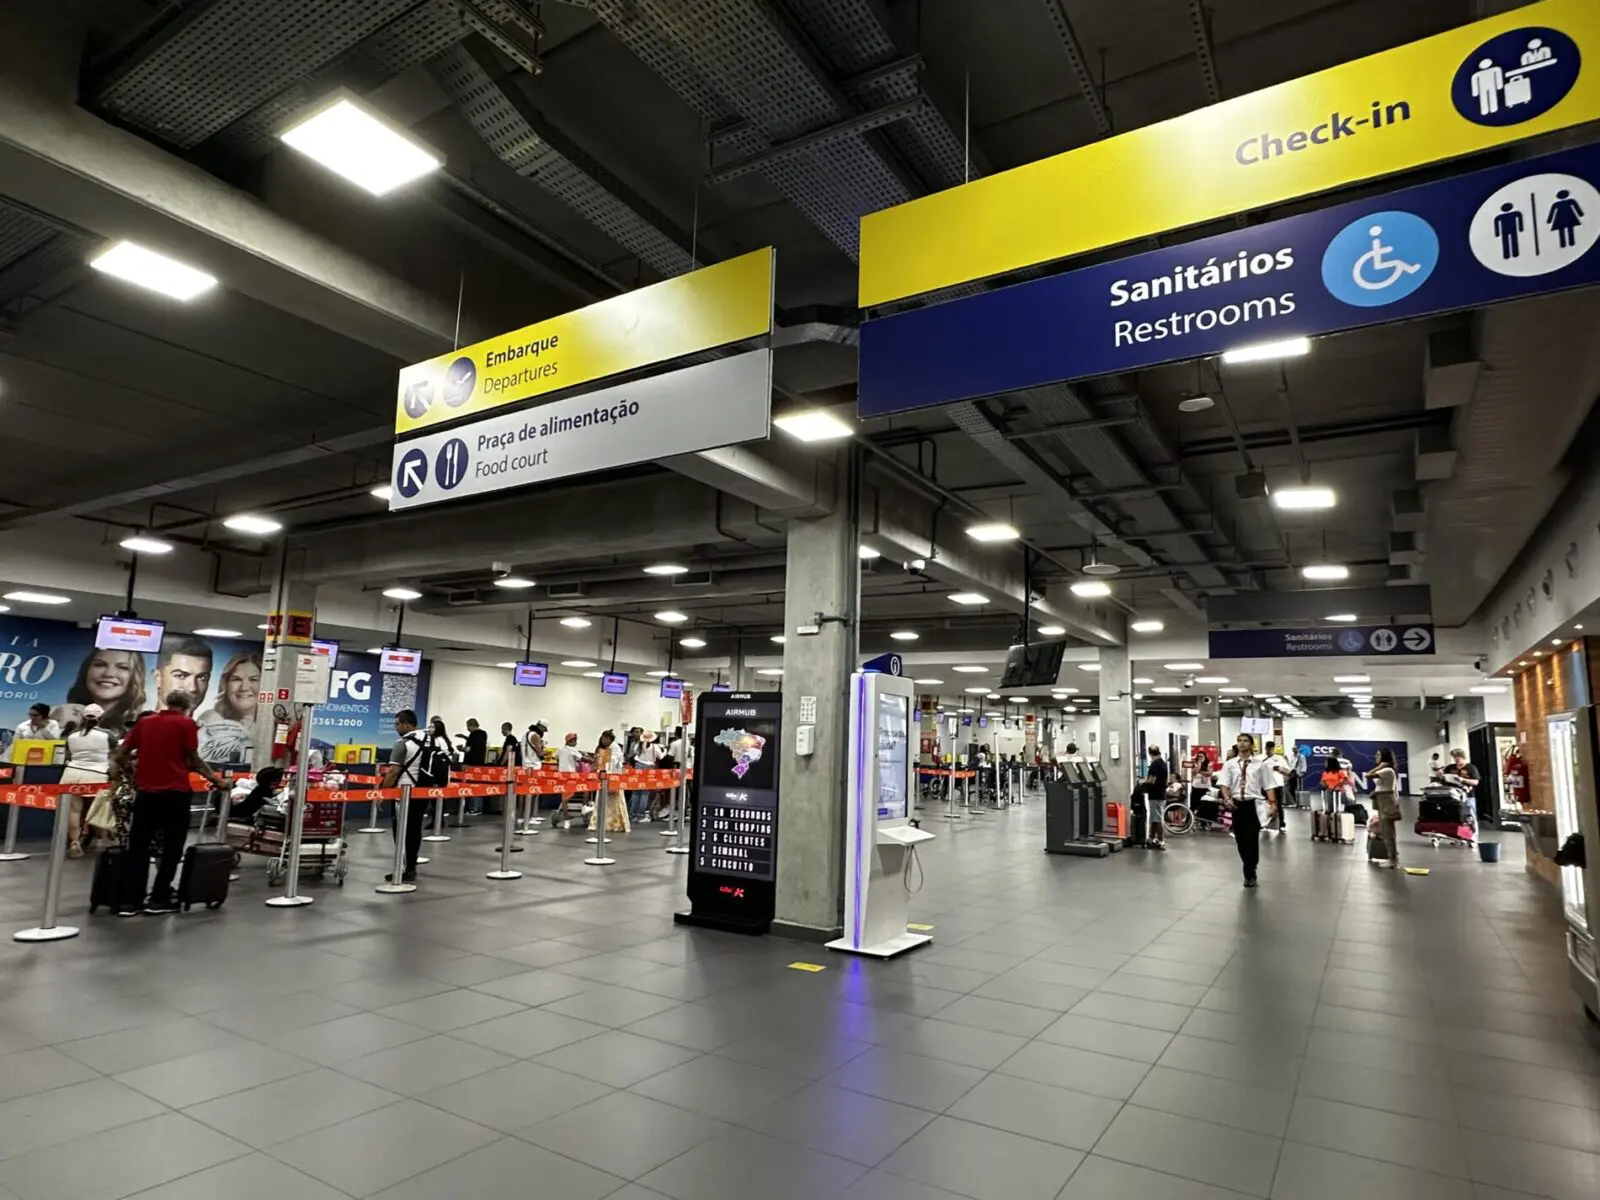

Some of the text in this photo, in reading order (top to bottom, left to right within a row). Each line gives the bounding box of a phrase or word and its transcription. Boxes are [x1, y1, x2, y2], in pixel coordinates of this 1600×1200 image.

[1236, 100, 1410, 165] Check-in
[1110, 247, 1294, 306] Sanitários
[1114, 292, 1296, 347] Restrooms
[486, 335, 559, 368] Embarque
[484, 361, 558, 394] Departures
[477, 399, 640, 452] Praça de alimentação
[475, 448, 549, 478] Food court
[1284, 632, 1333, 641] Sanitários
[1286, 642, 1333, 651] Restrooms
[330, 670, 371, 700] FG
[329, 789, 384, 801] GOL GOL
[428, 786, 501, 797] GOL GOL GOL
[730, 808, 772, 821] SEGUNDOS
[702, 819, 707, 828] 2
[735, 822, 772, 834] LOOPING
[701, 831, 706, 841] 3
[723, 834, 765, 847] CLIENTES
[700, 844, 749, 858] 4 SEMANAL
[712, 858, 753, 872] CIRCUITO
